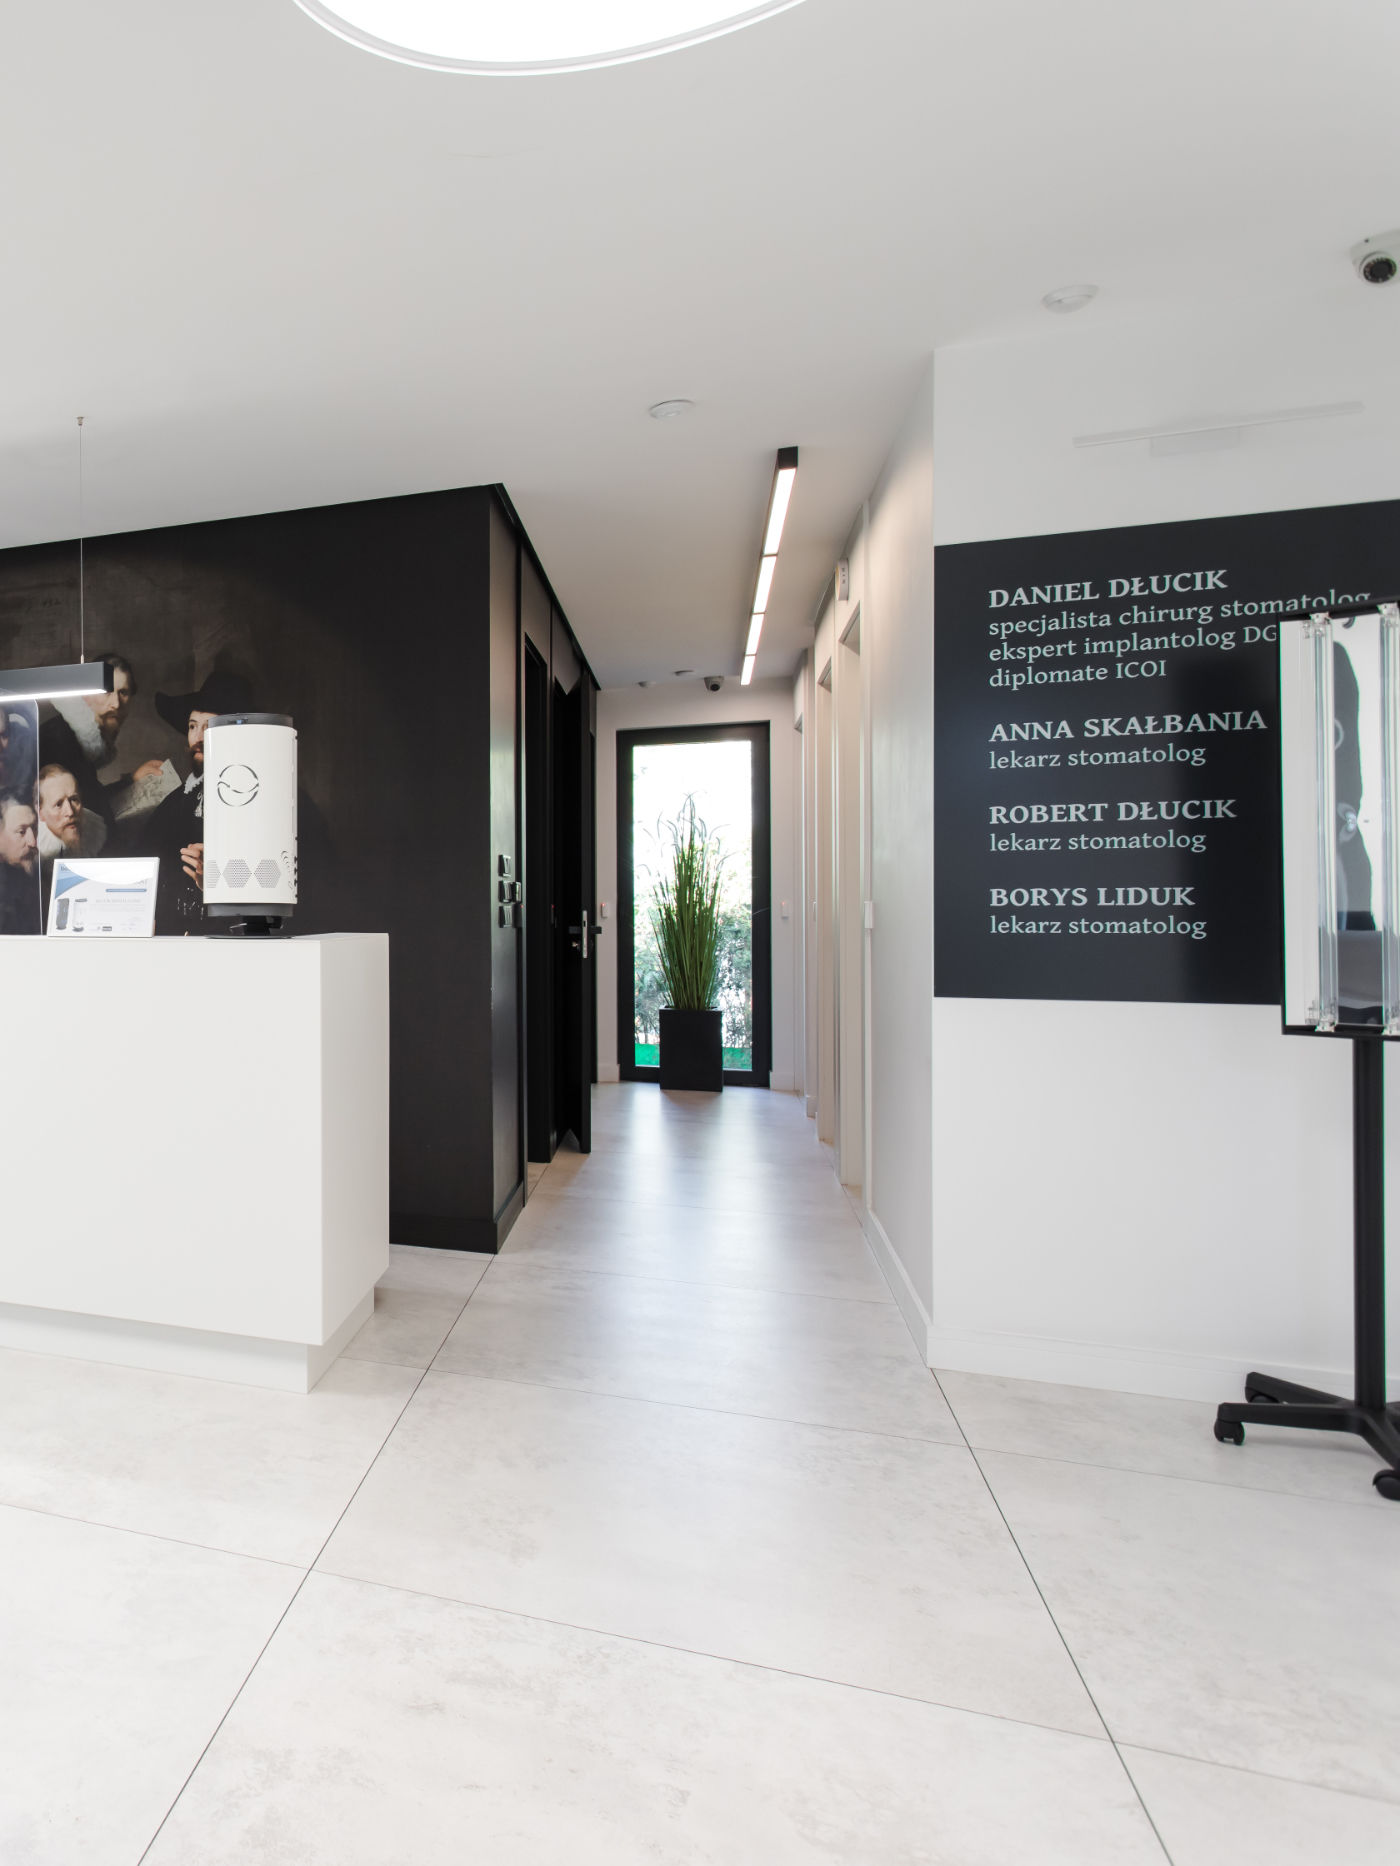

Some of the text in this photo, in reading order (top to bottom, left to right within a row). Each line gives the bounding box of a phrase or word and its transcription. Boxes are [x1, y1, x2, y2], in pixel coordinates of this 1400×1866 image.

[988, 569, 1228, 608] DANIEL DŁUCIK
[989, 611, 1112, 639] specjalista
[1119, 605, 1213, 624] chirurg
[989, 640, 1077, 663] ekspert
[1084, 627, 1236, 657] implantolog
[989, 660, 1167, 690] diplomate ICOI
[988, 710, 1268, 742] ANNA SKAŁBANIA
[989, 743, 1206, 769] lekarz stomatolog
[989, 799, 1238, 824] ROBERT DŁUCIK
[990, 829, 1206, 853] lekarz stomatolog
[990, 887, 1196, 906] BORYS LIDUK
[990, 915, 1207, 939] lekarz stomatolog
